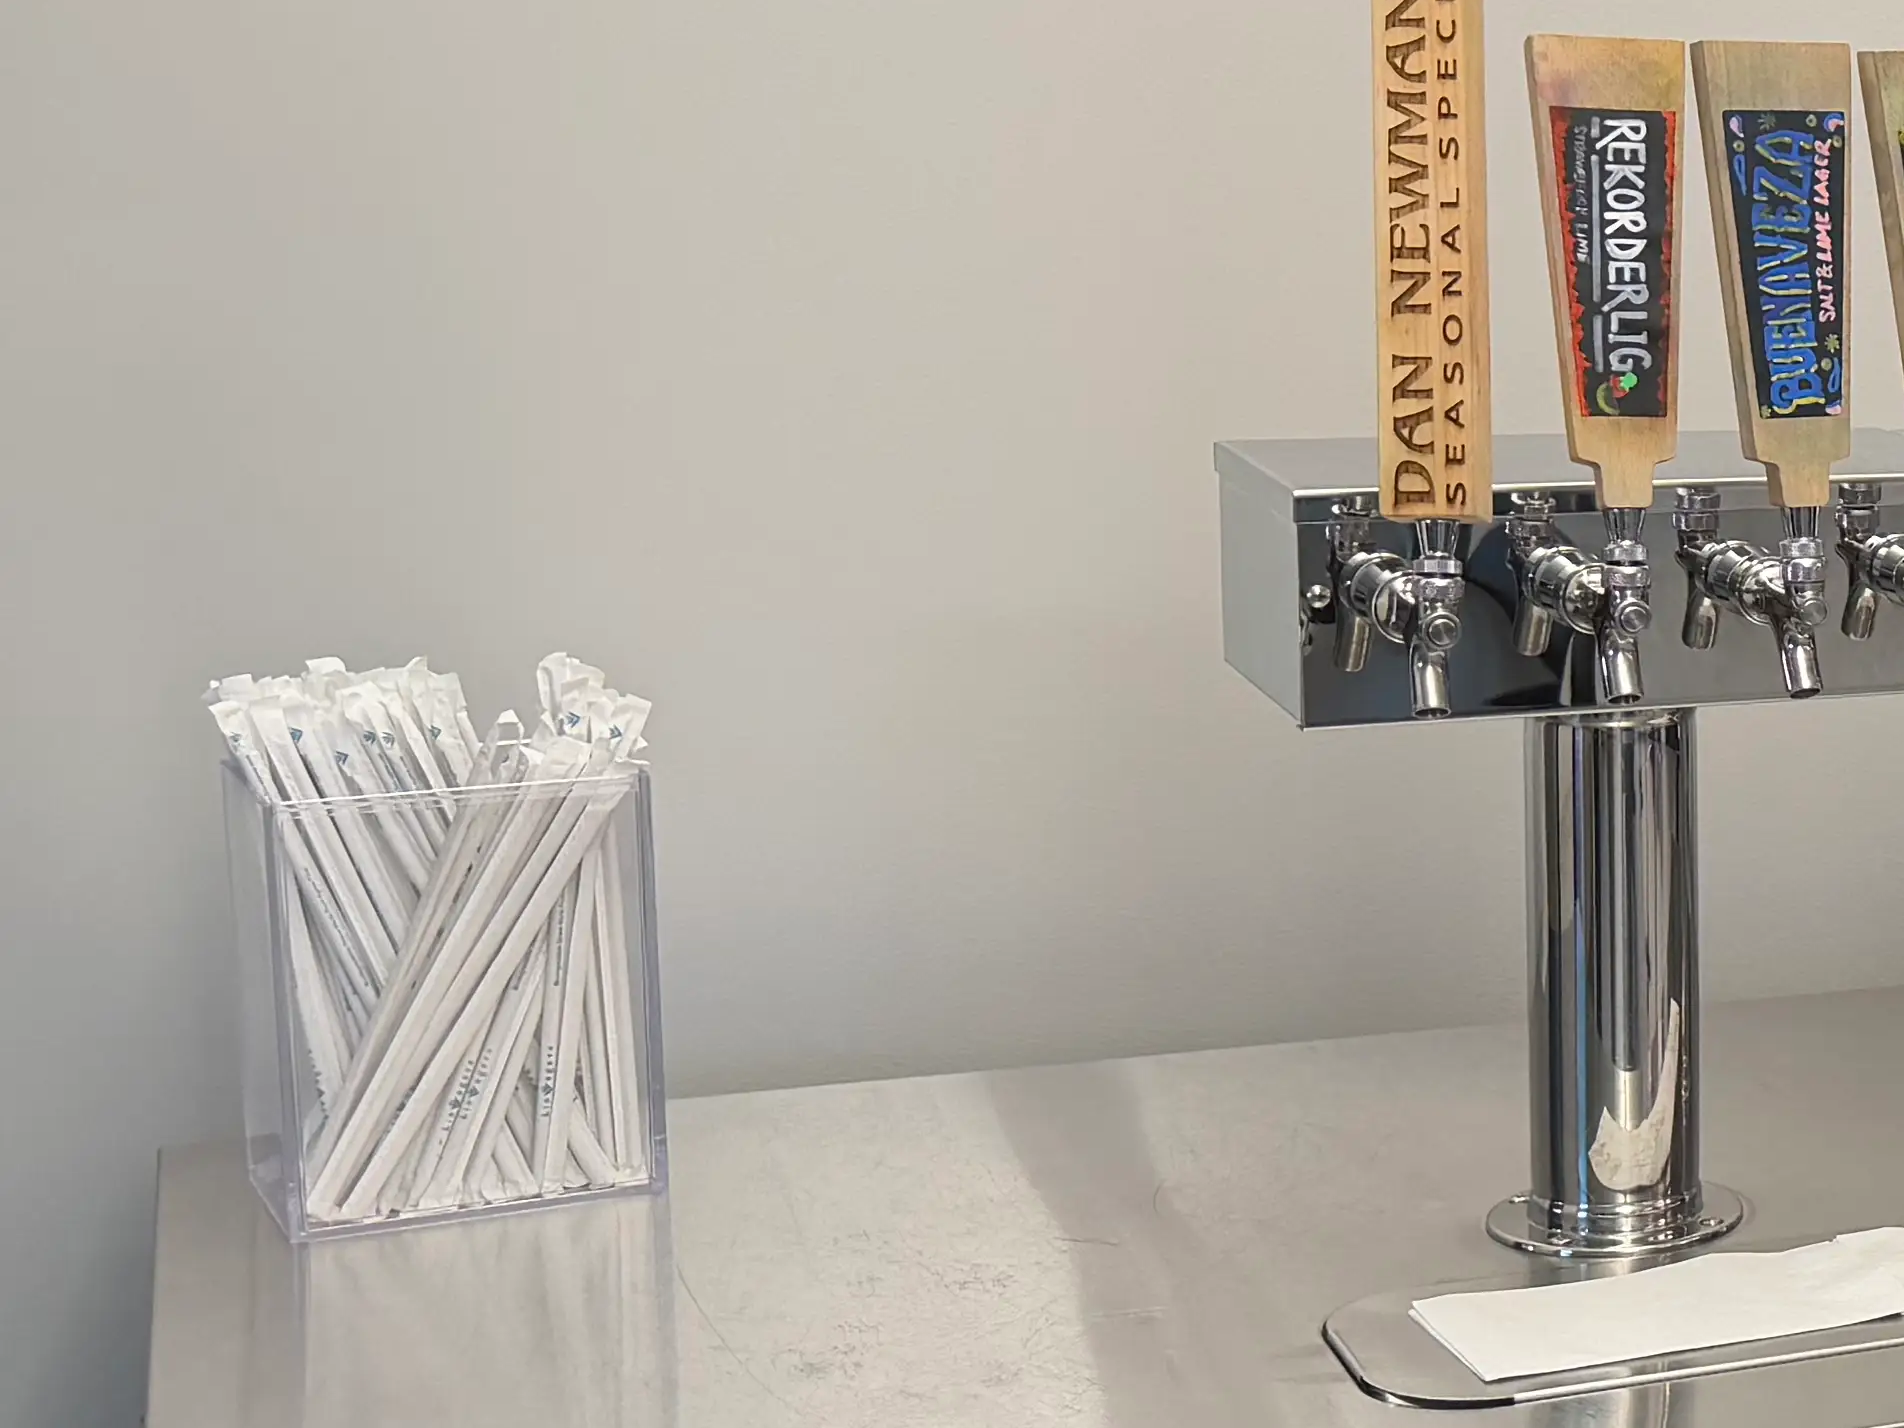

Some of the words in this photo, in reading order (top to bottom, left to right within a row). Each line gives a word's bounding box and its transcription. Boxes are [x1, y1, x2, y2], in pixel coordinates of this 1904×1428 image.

[1595, 118, 1652, 372] REKORDERLIG
[1812, 138, 1832, 206] LAGER
[1392, 354, 1436, 508] DAN
[1440, 187, 1467, 507] SEASONAL
